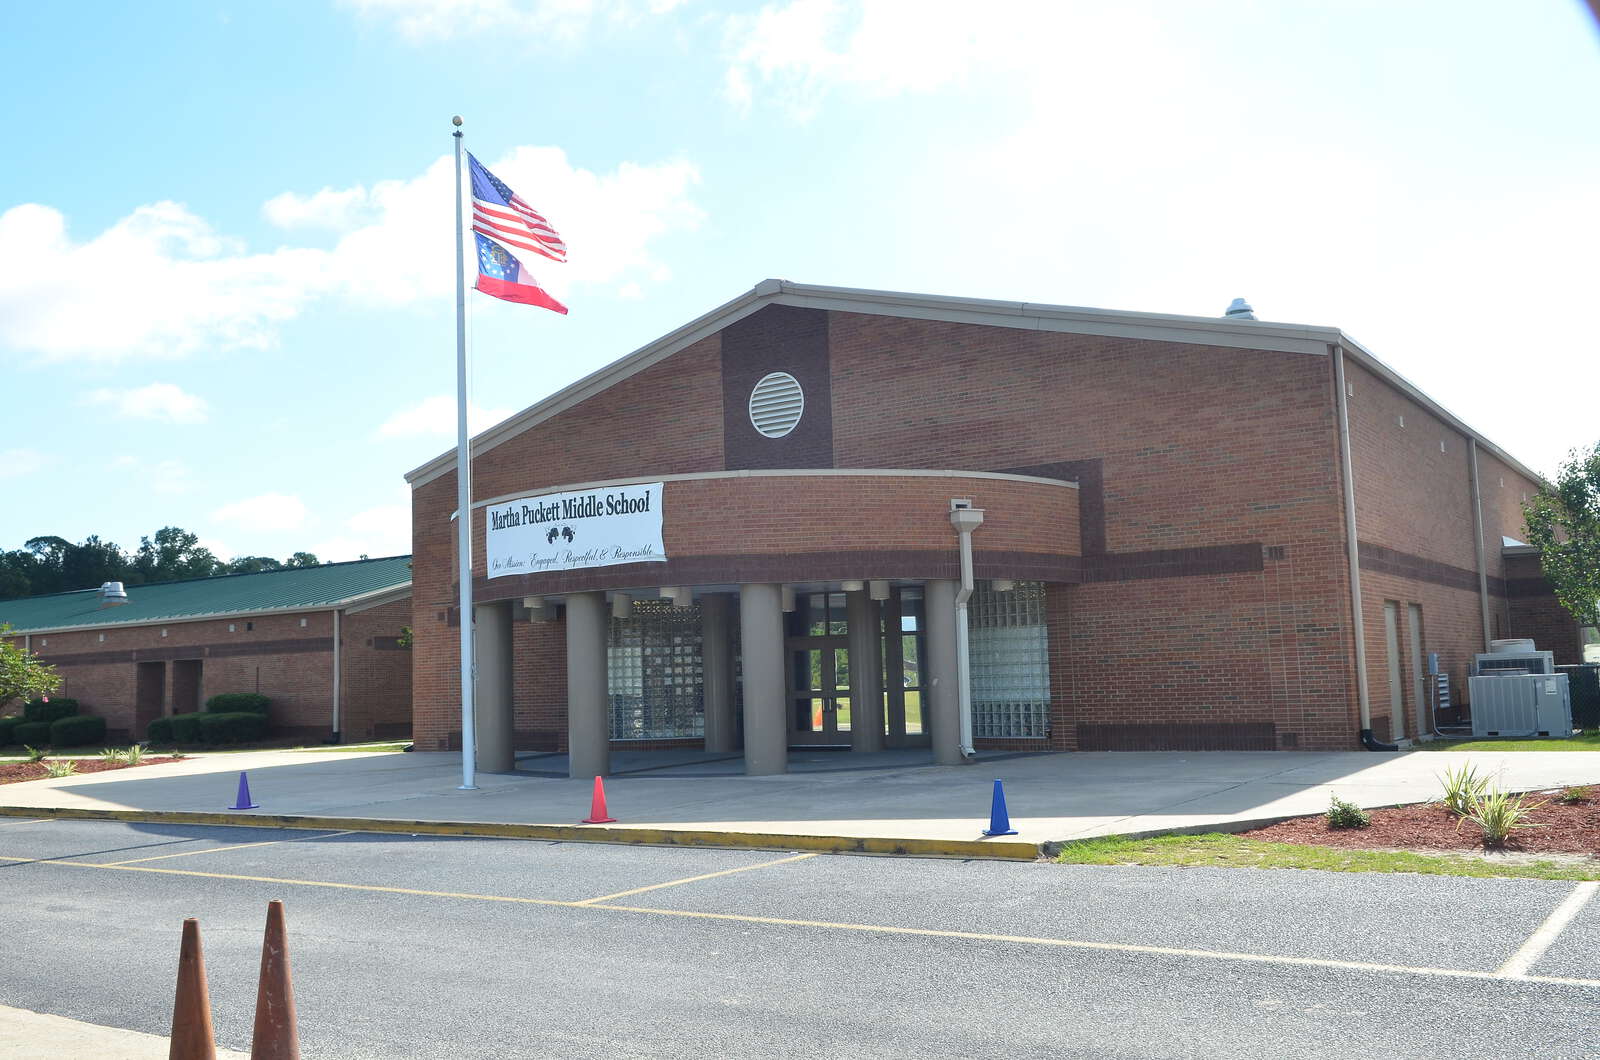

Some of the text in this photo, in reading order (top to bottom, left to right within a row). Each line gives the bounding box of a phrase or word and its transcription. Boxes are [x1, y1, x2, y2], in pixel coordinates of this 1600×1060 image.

[491, 490, 650, 531] Martha Puckett Middle School
[492, 558, 502, 570] Our
